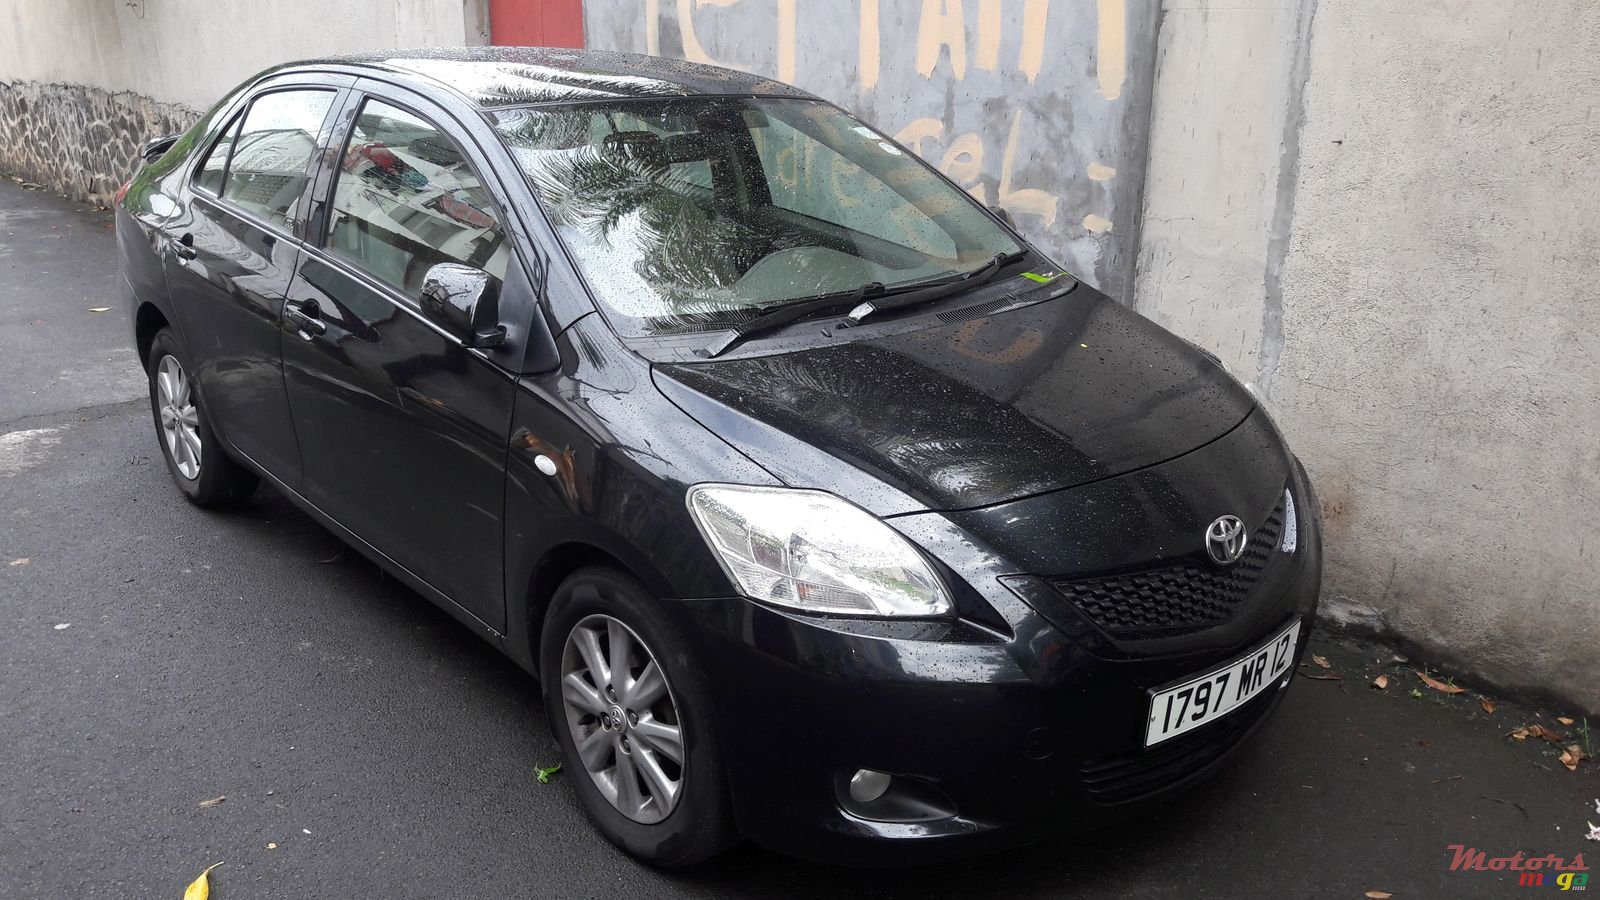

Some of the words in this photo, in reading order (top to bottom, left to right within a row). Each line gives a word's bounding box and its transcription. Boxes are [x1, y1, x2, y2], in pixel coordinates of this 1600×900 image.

[1162, 672, 1231, 734] 1797
[1236, 652, 1268, 701] MR
[1270, 634, 1291, 677] 12
